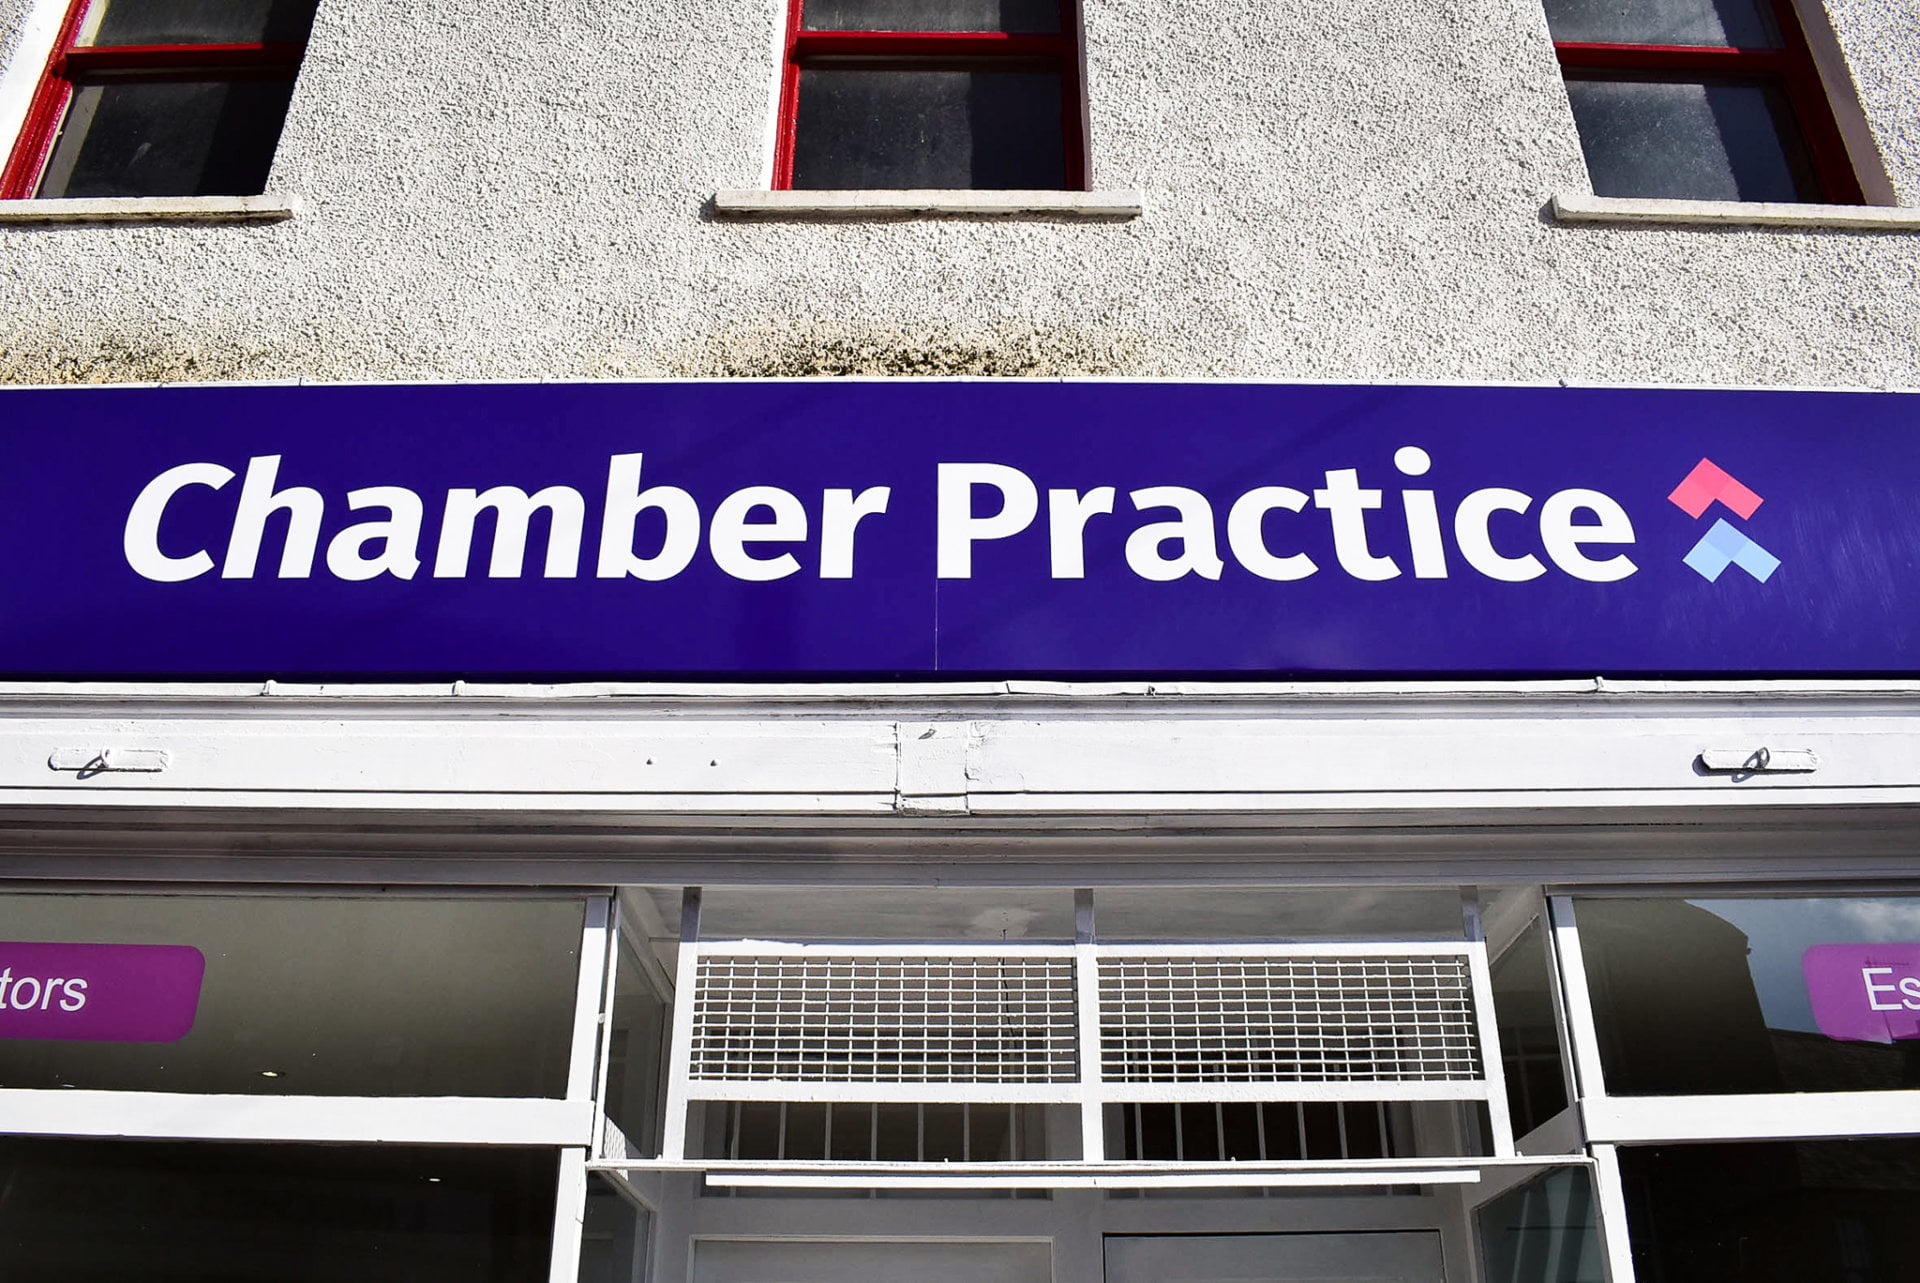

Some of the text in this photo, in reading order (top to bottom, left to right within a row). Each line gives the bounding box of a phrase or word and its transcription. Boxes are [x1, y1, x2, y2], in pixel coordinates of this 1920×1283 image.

[123, 446, 1639, 583] Chamber Practice
[0, 967, 88, 1011] tors
[1861, 967, 1920, 1011] Es
